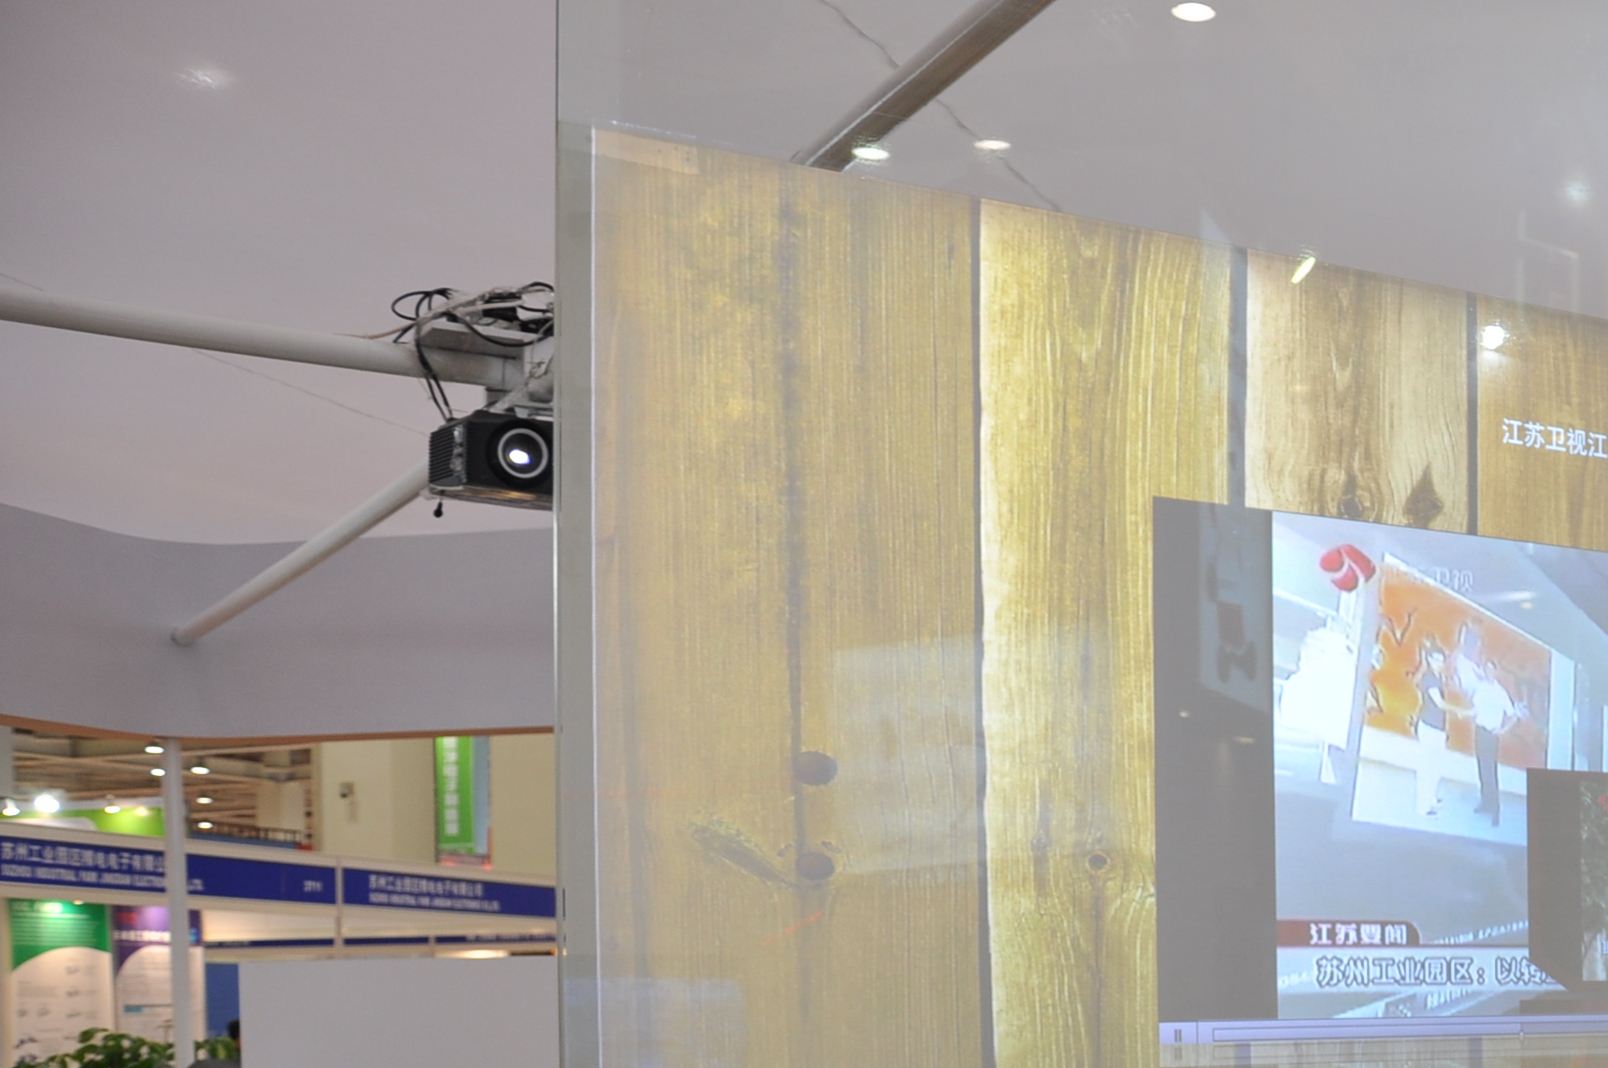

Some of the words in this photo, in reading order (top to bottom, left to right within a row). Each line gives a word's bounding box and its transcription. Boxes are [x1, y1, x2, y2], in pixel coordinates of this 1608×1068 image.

[1310, 922, 1408, 946] 江苏要闻
[1315, 955, 1558, 988] 苏州工业园区：以转
